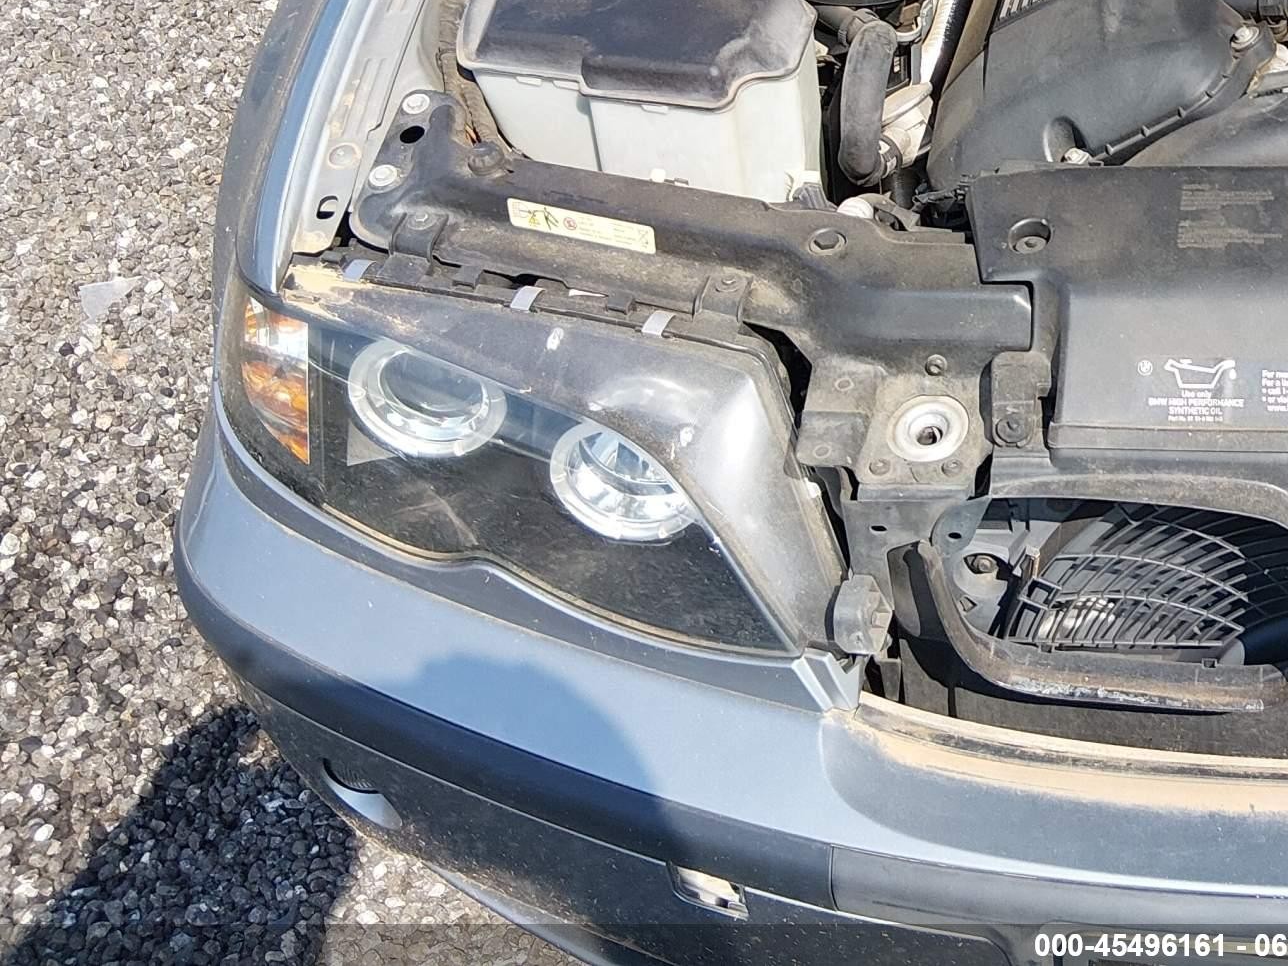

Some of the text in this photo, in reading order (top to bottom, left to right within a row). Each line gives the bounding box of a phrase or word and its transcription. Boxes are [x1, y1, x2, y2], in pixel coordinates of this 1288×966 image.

[1262, 369, 1274, 378] For
[1262, 378, 1273, 387] For
[1182, 390, 1212, 399] Use only
[1148, 397, 1244, 407] BMW HIGH PERFORMANCE
[1168, 406, 1223, 415] SYNTHETIC OIL
